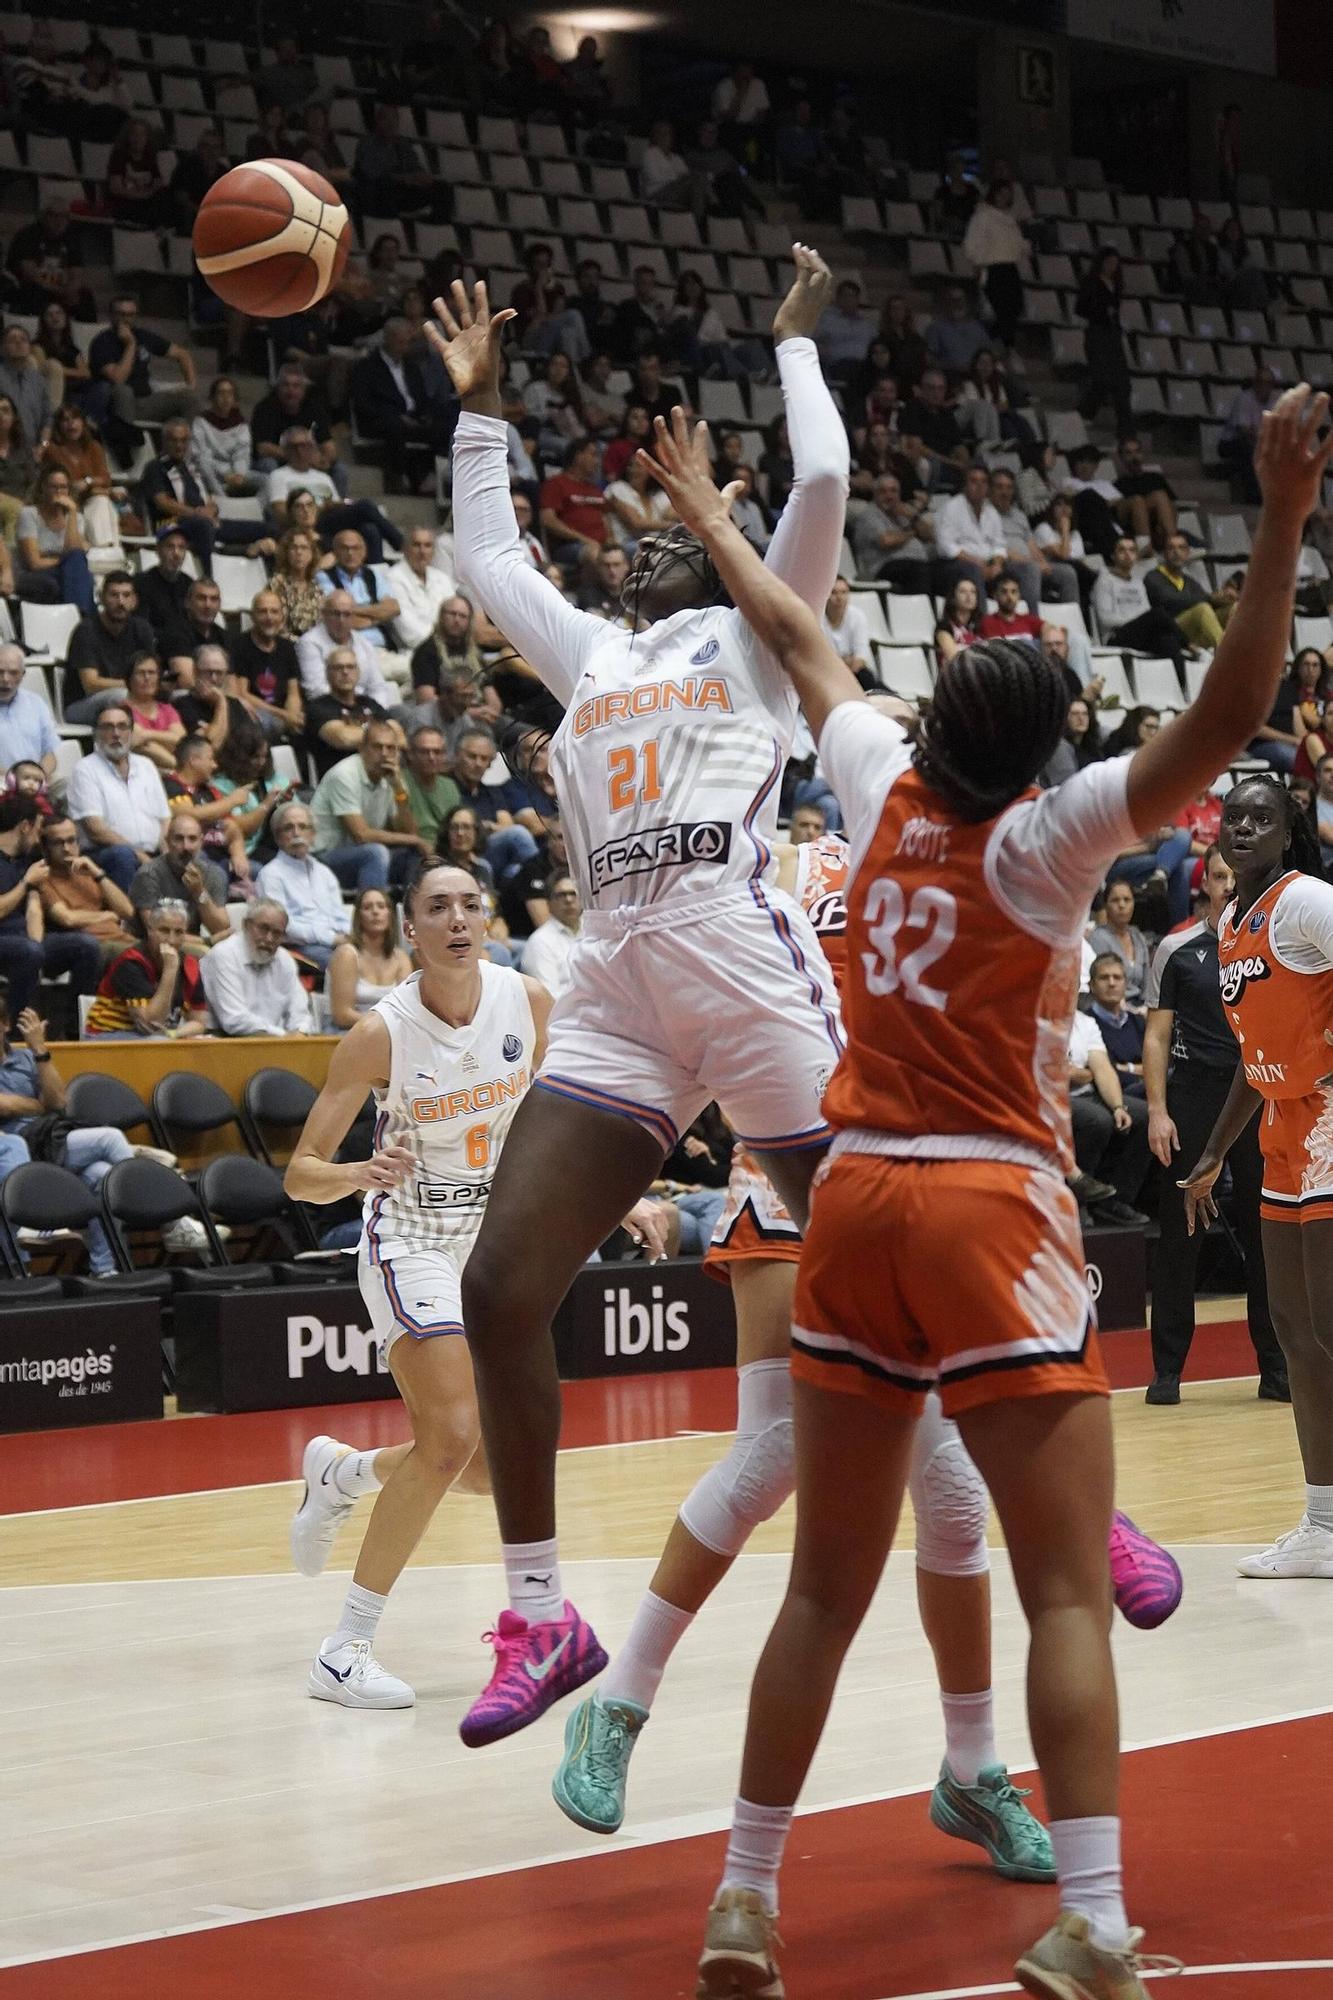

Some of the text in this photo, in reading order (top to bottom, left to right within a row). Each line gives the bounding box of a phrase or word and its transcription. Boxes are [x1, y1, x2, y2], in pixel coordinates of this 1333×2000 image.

[572, 677, 734, 739] GIRONA
[607, 736, 664, 815] 21
[860, 877, 958, 1012] 32
[465, 1122, 492, 1170] 6
[428, 1187, 489, 1202] SPA
[286, 1315, 390, 1379] Pun
[603, 1285, 691, 1357] ibis
[0, 1348, 113, 1386] mtapagès
[90, 1380, 113, 1394] 1945
